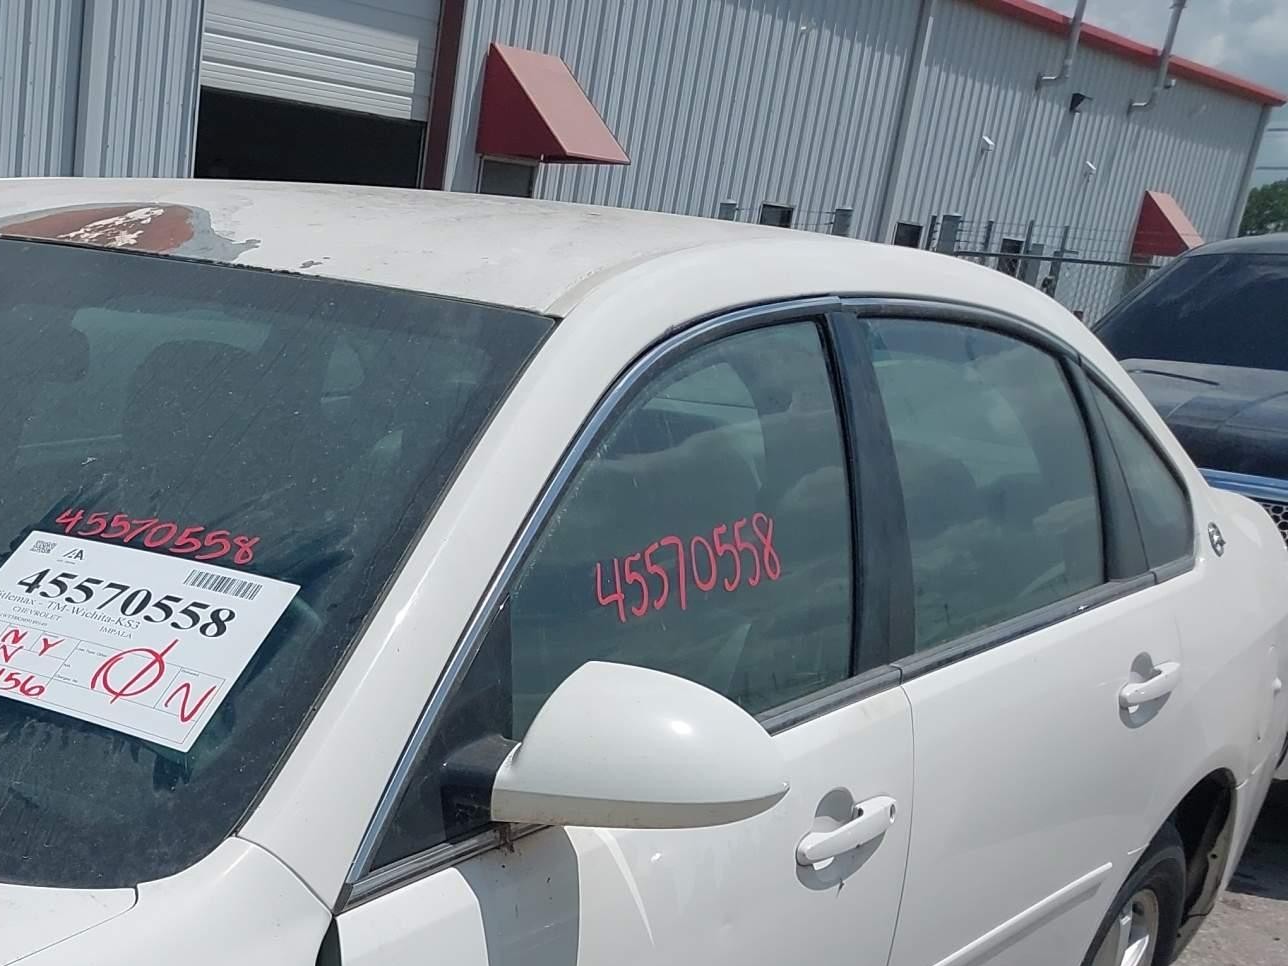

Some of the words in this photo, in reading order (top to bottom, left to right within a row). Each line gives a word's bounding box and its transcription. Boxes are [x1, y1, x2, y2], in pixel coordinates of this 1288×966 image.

[56, 508, 260, 565] 45570558
[595, 512, 782, 623] 45570558
[17, 568, 237, 639] 45570558
[47, 600, 141, 630] TM-Wichita-KS3
[38, 638, 66, 657] Y
[99, 625, 133, 640] IMPALA
[165, 682, 217, 723] N
